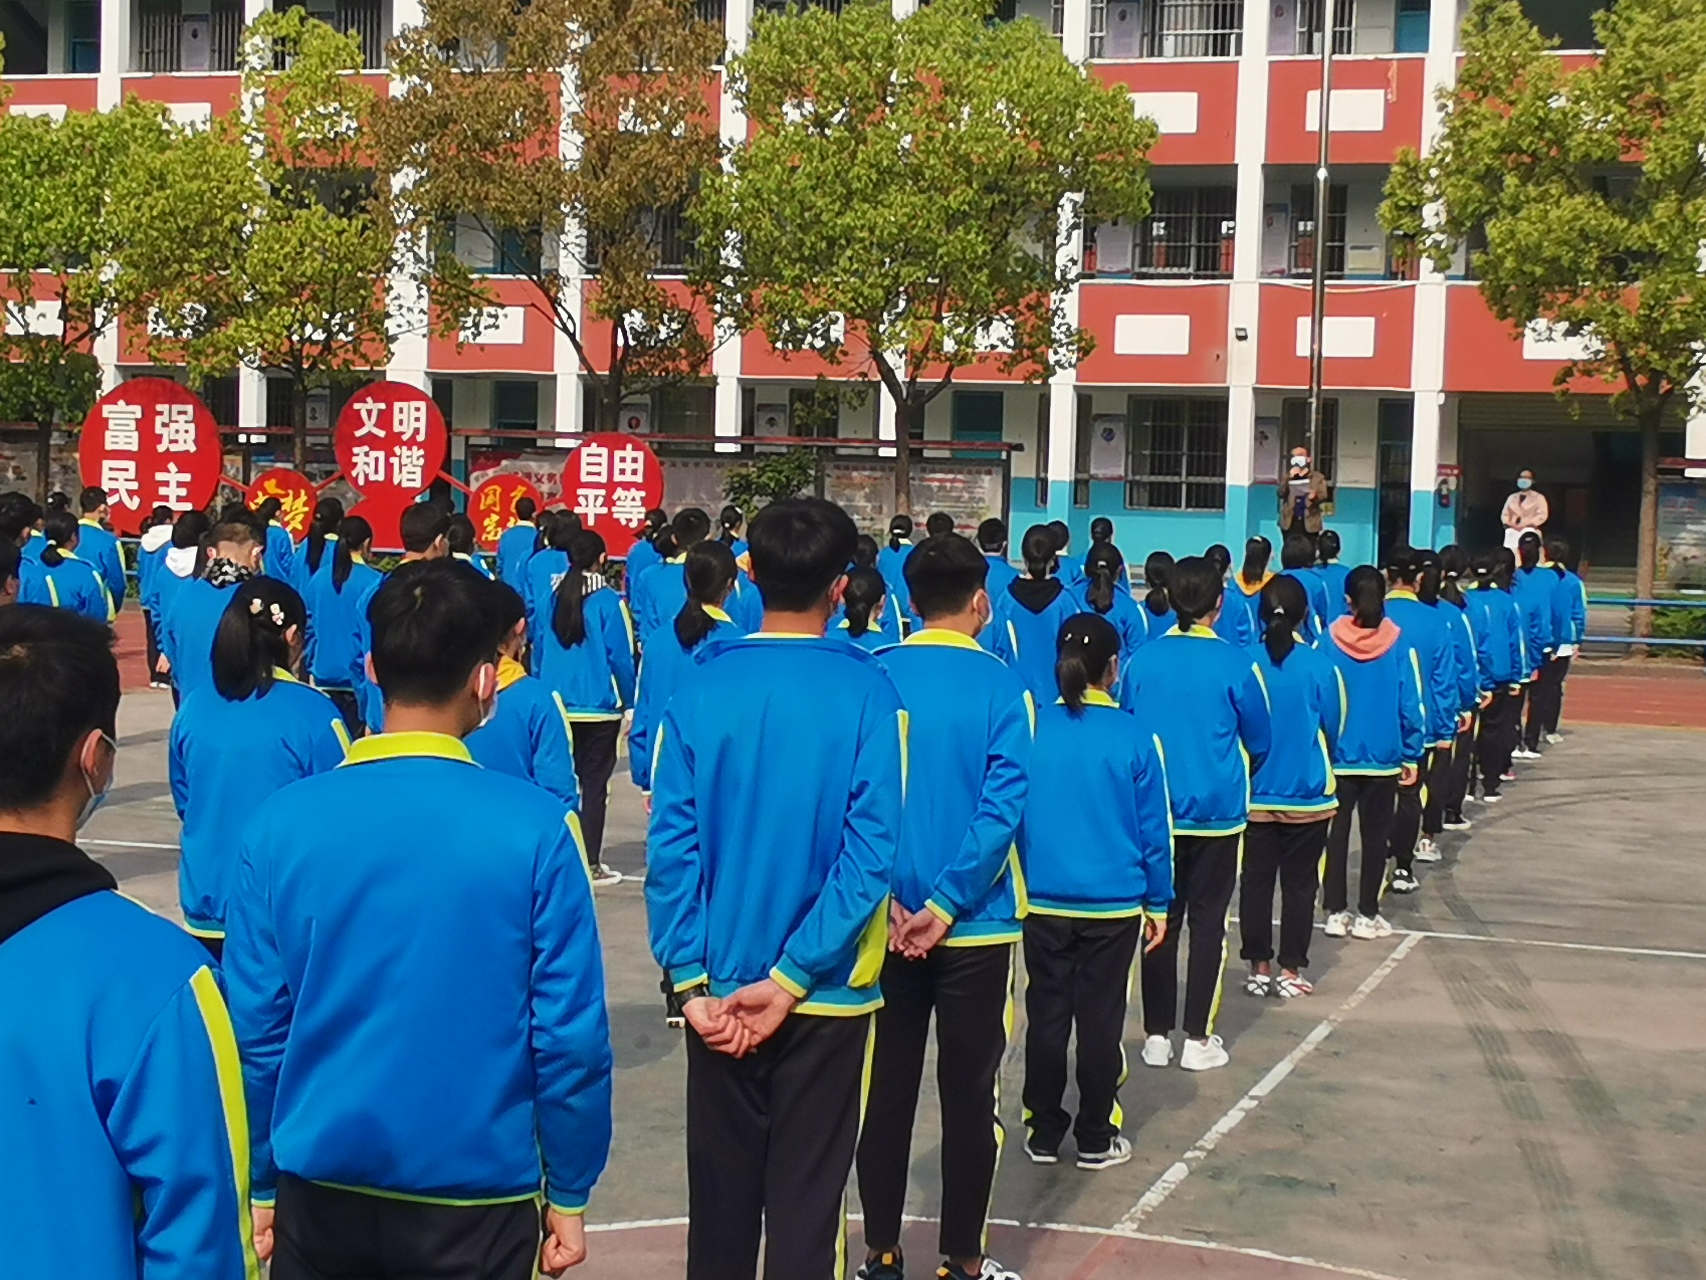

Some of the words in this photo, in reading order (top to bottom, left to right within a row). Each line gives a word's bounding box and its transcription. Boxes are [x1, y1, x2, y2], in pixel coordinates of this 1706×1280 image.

[101, 399, 197, 453] 富强
[352, 396, 427, 442] 文明
[100, 459, 193, 511] 民主
[350, 445, 425, 489] 和谐
[579, 442, 645, 483] 自由
[573, 486, 647, 528] 平等
